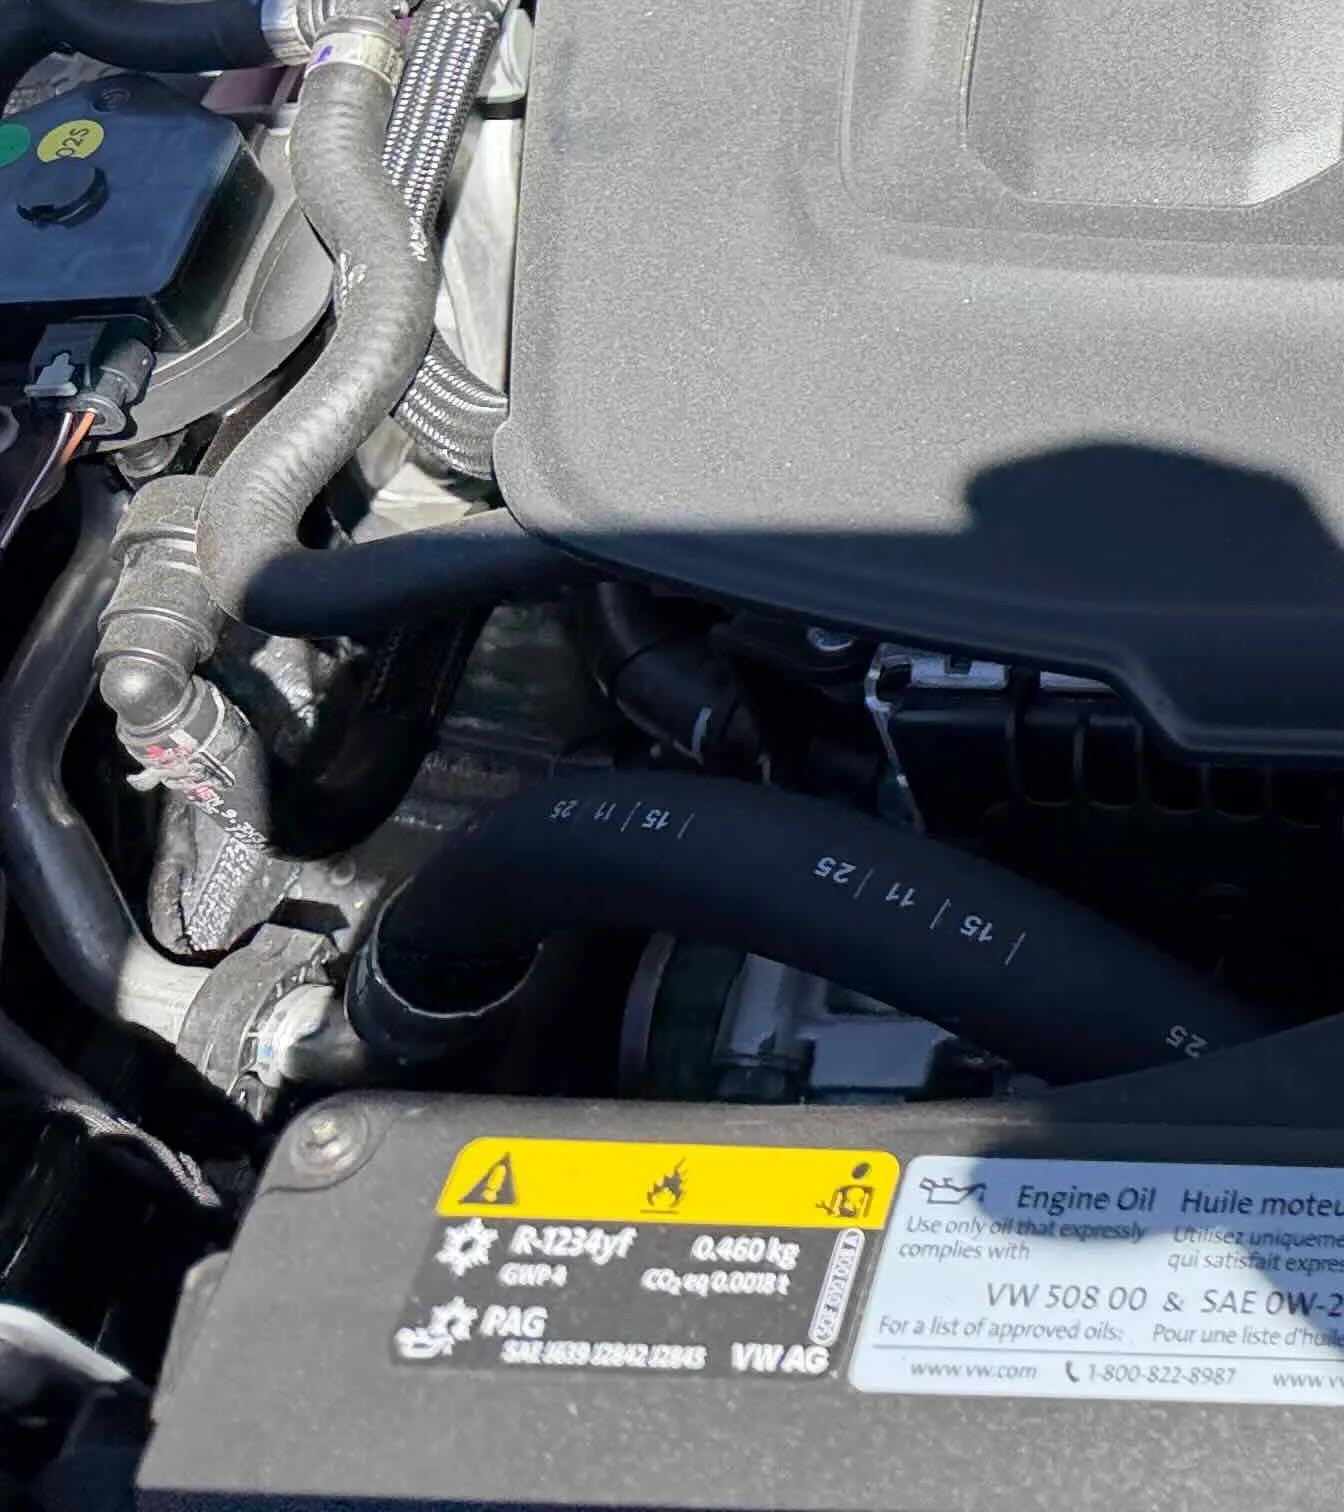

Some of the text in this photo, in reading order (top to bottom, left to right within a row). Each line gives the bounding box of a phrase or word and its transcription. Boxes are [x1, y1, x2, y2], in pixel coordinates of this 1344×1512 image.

[812, 856, 855, 884] 25
[959, 914, 993, 942] 15
[1166, 1025, 1208, 1059] 25
[1016, 1184, 1157, 1216] Engine Oil
[1181, 1188, 1254, 1215] Huile
[907, 1215, 1148, 1243] Use only oil that expressly
[1173, 1225, 1244, 1245] Utilisez
[510, 1225, 800, 1270] R-1234yf 0.460 kg
[899, 1241, 1030, 1263] complies with
[1167, 1251, 1200, 1273] qui
[1203, 1251, 1281, 1272] satisfait
[986, 1282, 1040, 1308] VW
[1044, 1284, 1100, 1310] 508
[1107, 1286, 1147, 1312] 00
[1162, 1291, 1184, 1312] &
[1200, 1288, 1257, 1314] SAE
[480, 1304, 548, 1337] PAG
[879, 1315, 1126, 1344] For a list of approved oils:
[1152, 1323, 1197, 1343] Pour
[1200, 1328, 1237, 1344] une
[1241, 1324, 1281, 1345] liste
[731, 1342, 785, 1372] VW
[780, 1344, 829, 1374] AG
[910, 1362, 1037, 1380] www.vw.com
[1087, 1363, 1237, 1386] 1-800-822-8987
